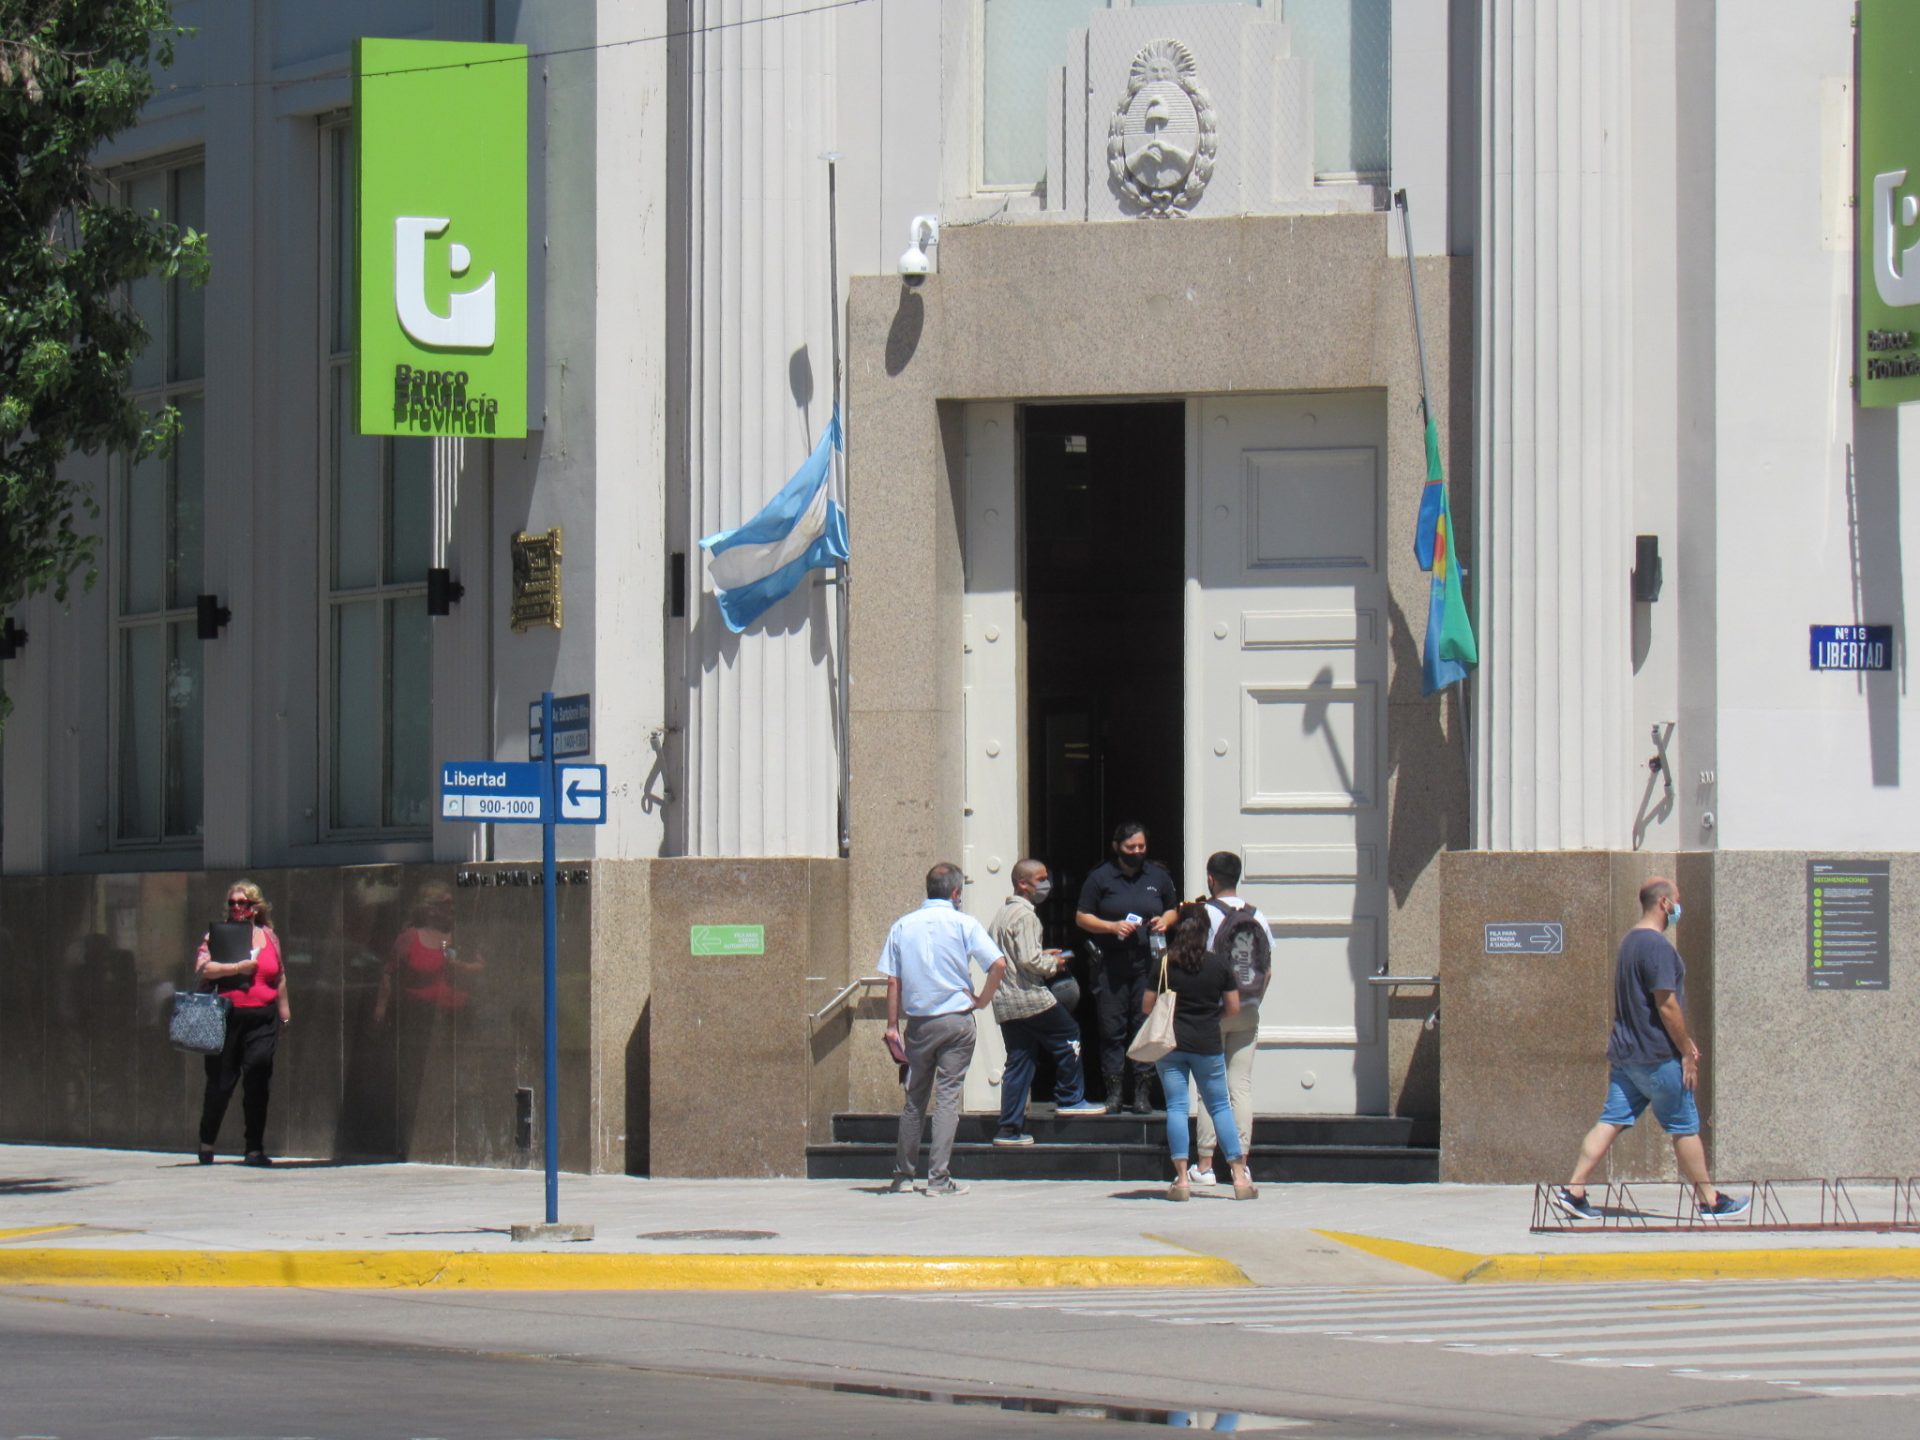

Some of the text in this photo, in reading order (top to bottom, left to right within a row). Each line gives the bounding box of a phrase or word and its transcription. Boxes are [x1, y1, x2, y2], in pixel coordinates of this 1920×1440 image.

[395, 363, 469, 386] Banco
[394, 389, 498, 415] Provincia
[1852, 627, 1867, 640] 16
[1818, 641, 1883, 668] LIBERTAD
[444, 770, 506, 787] Libertad
[479, 799, 534, 814] 900-1000
[1813, 876, 1869, 884] RECOMENDACIONES
